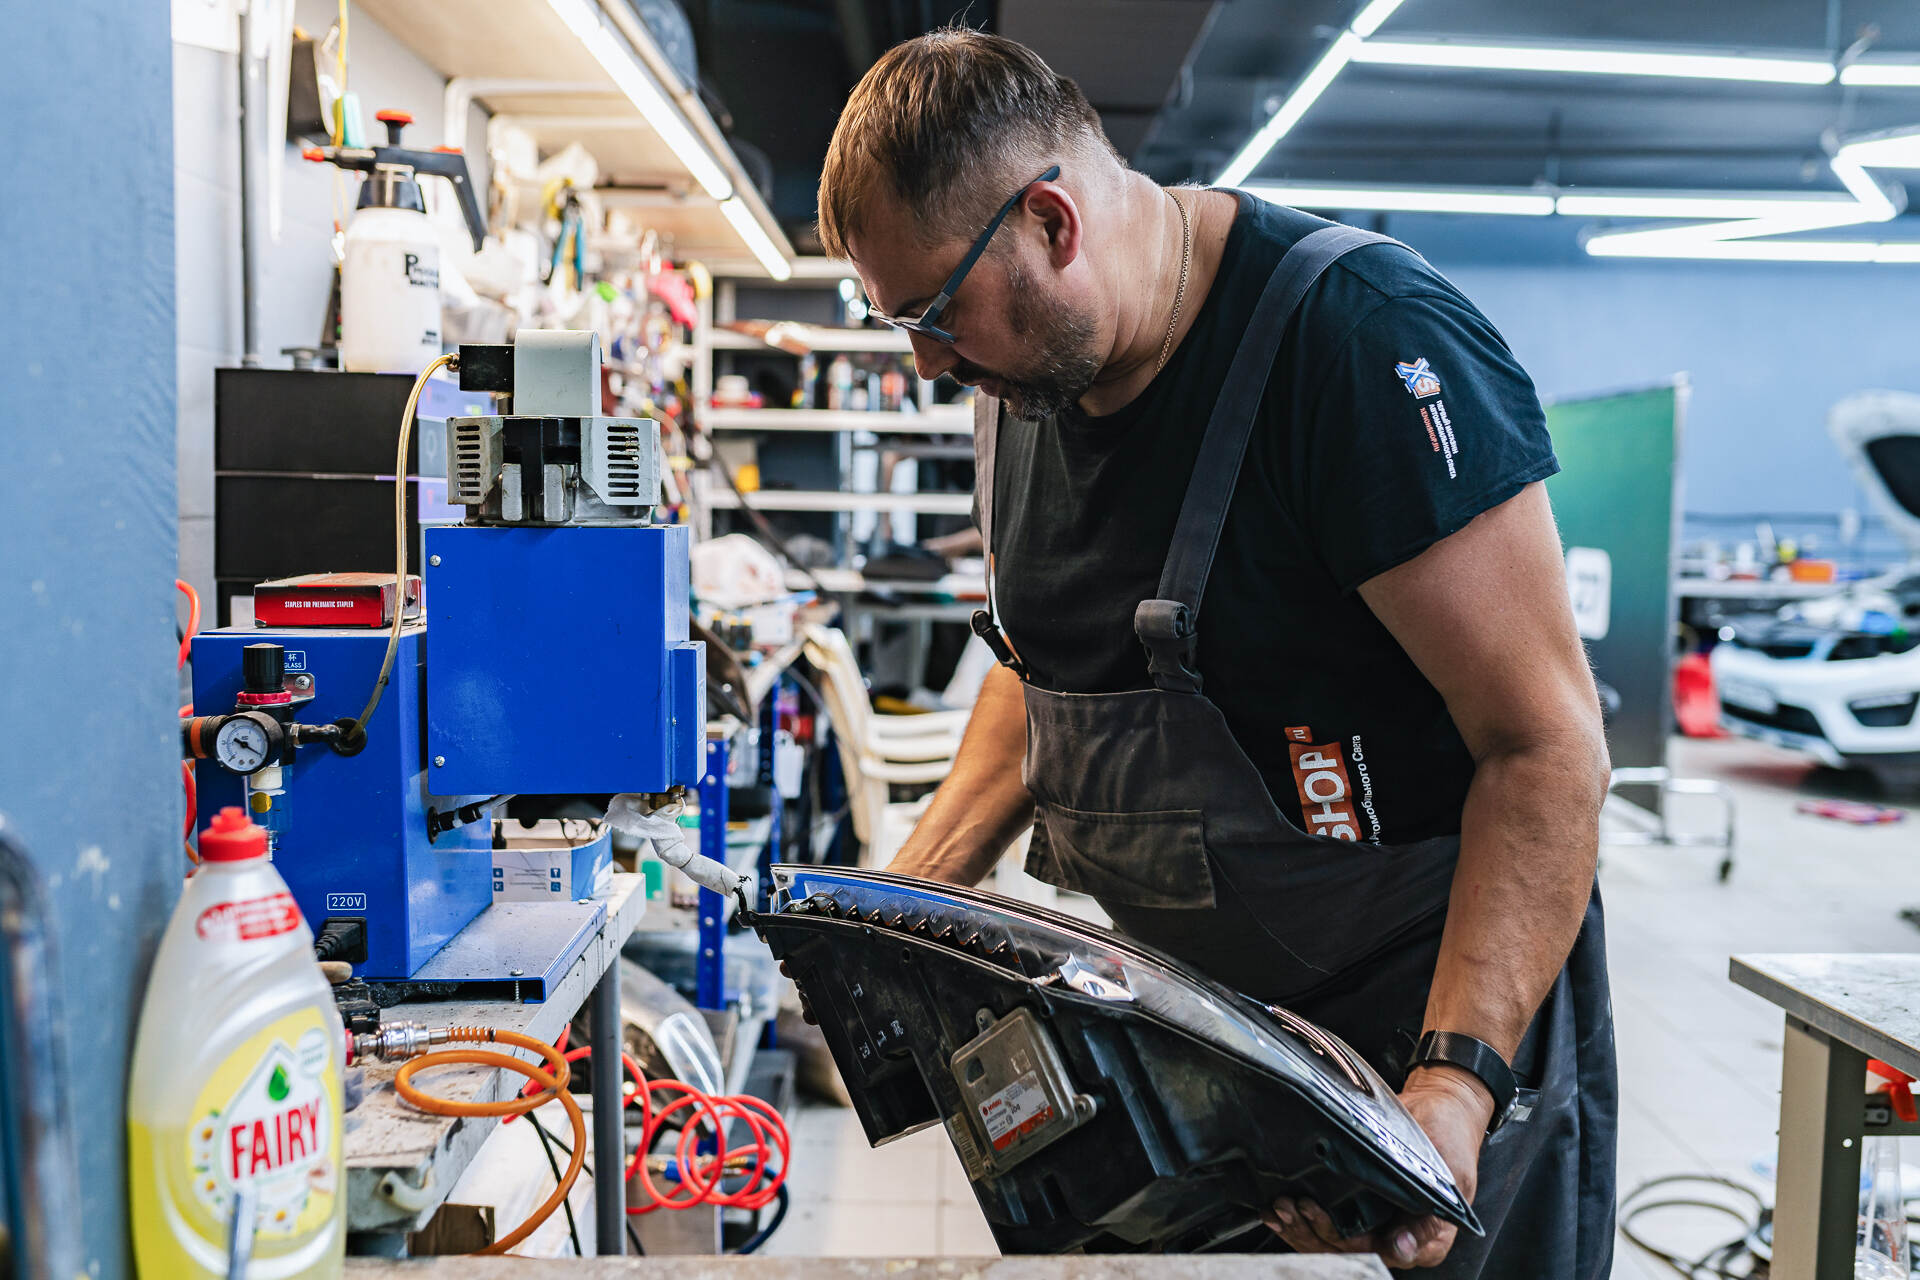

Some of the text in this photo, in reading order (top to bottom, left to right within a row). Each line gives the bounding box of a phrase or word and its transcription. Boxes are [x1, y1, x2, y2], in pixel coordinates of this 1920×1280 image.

[1428, 404, 1457, 479] АВТОМОБИЛЬНОГО СВЕТА
[1444, 424, 1459, 454] МАГАЗИН
[1293, 729, 1306, 739] ru
[1352, 735, 1364, 762] Света
[331, 896, 362, 907] 220V
[230, 1098, 321, 1181] FAIRY
